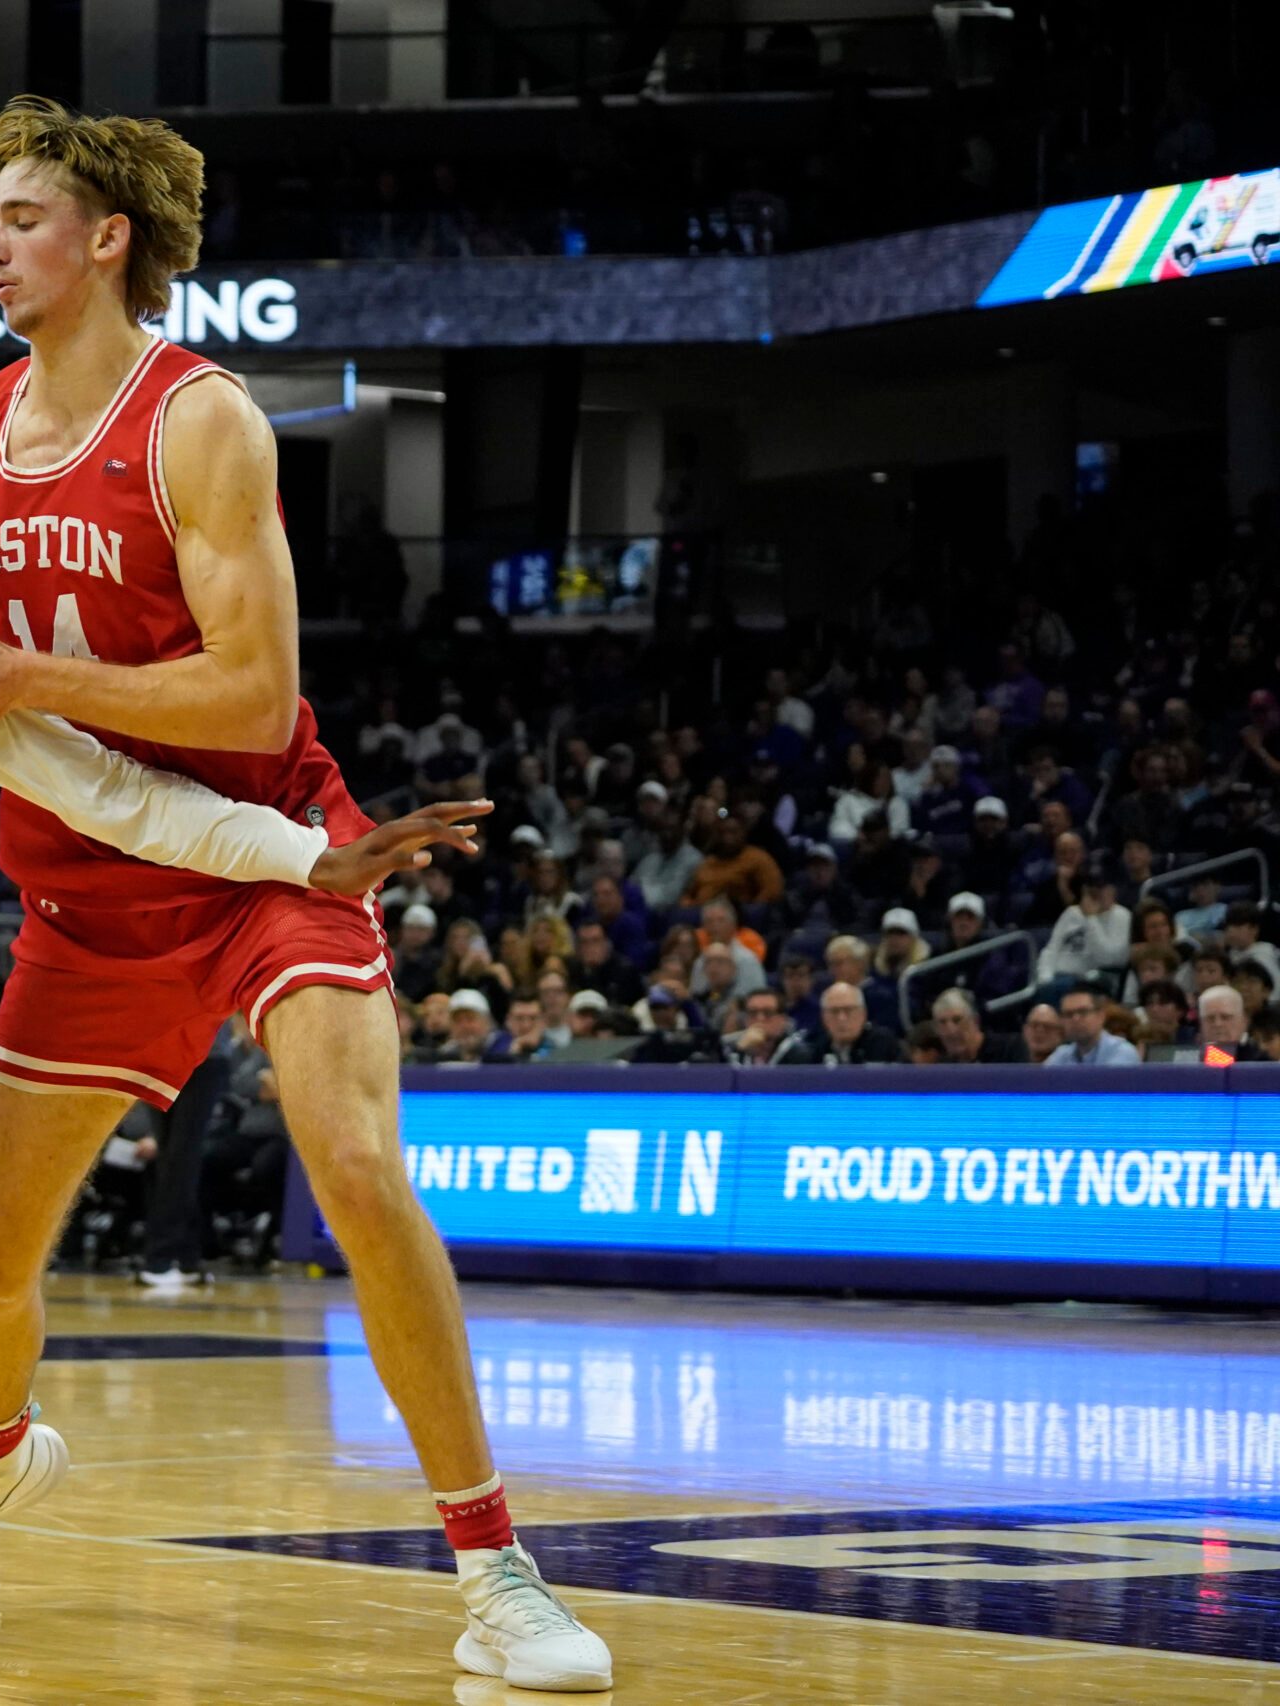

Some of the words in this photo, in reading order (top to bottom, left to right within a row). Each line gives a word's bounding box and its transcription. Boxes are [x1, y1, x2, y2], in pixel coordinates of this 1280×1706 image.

[8, 592, 101, 664] 14
[677, 1129, 723, 1216] N
[783, 1145, 934, 1202] PROUD
[940, 1146, 999, 1204] TO
[1002, 1147, 1075, 1206] FLY
